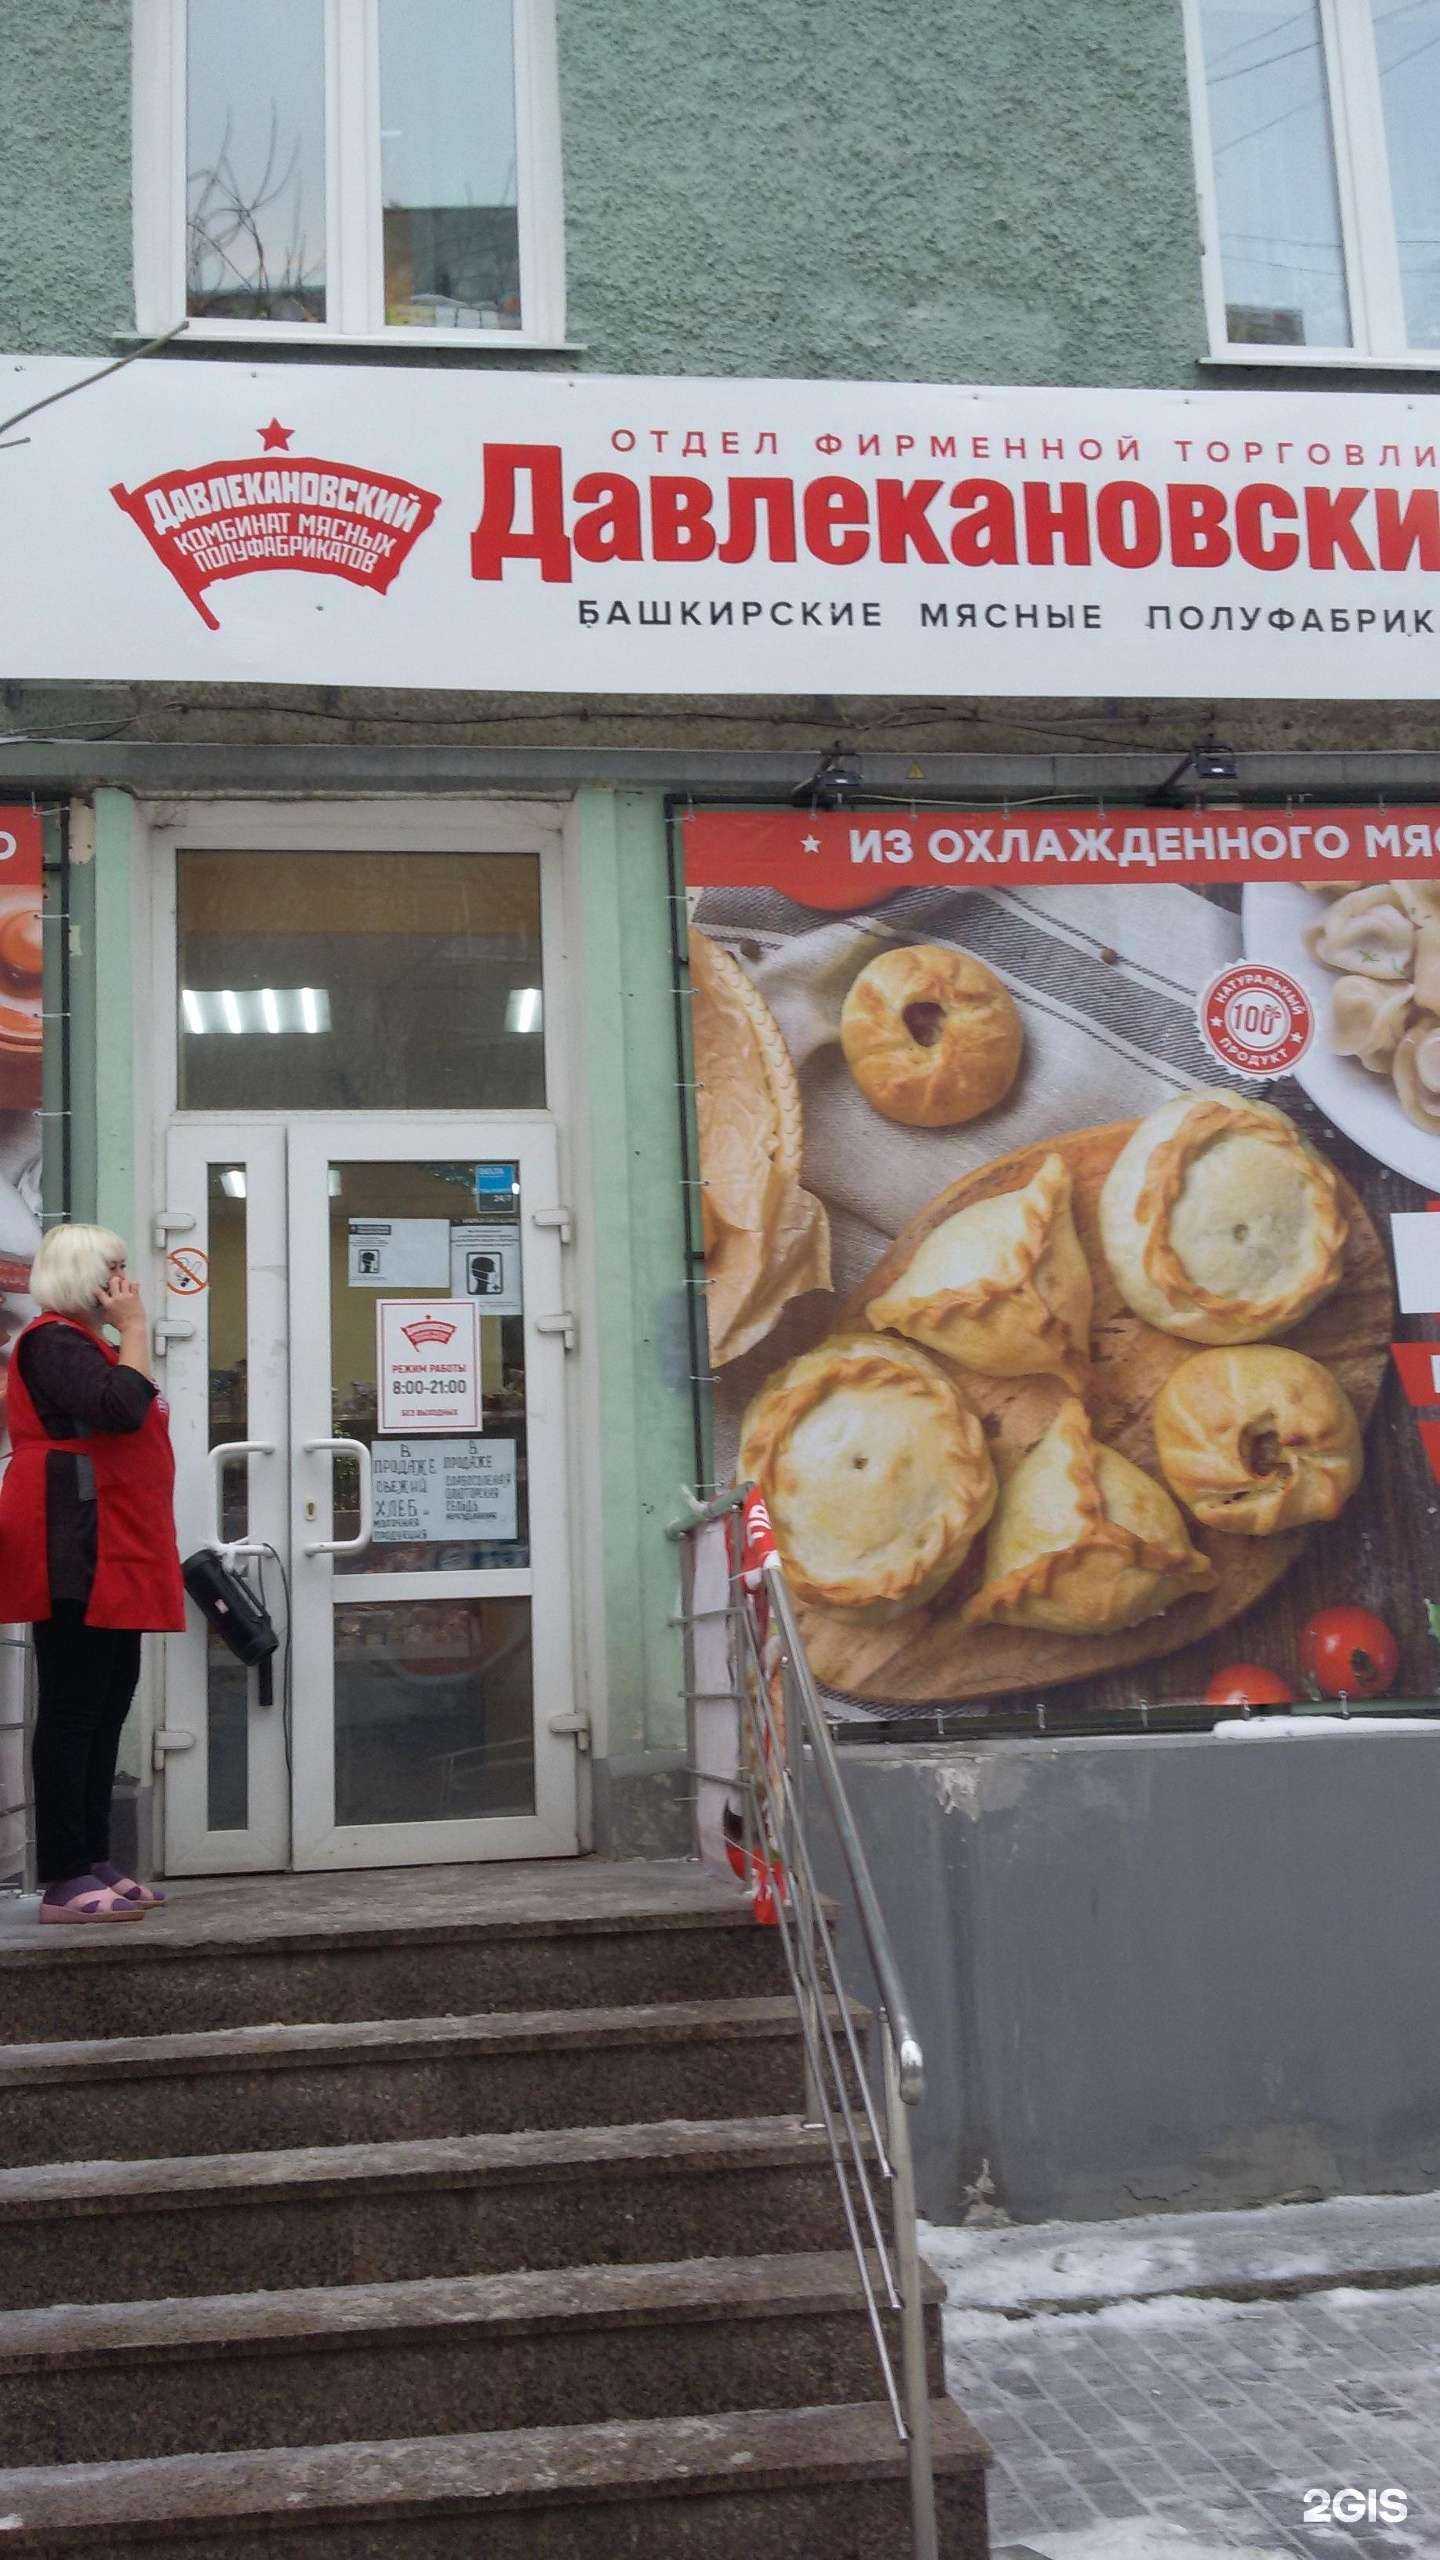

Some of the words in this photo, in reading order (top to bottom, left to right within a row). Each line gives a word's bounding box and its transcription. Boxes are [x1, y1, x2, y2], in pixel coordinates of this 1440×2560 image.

[611, 428, 778, 457] ОТДЕЛ
[815, 433, 1140, 463] ФИРМЕННОЙ
[1174, 440, 1436, 468] ТОРГОВЛИ
[144, 471, 422, 536] ДАВЛЕКАНОВСКИЙ
[470, 442, 1440, 584] Давлекановски
[173, 513, 291, 555] КОМБИНАТ
[298, 513, 398, 557] МЯСНЫХ
[192, 535, 380, 574] ПОЛУФАБРИКАТОВ
[578, 600, 882, 627] БАШКИРСКИЕ
[921, 603, 1101, 629] МЯСНЫЕ
[1147, 606, 1435, 634] ПОЛУФАБРИК
[850, 828, 914, 864] ИЗ
[927, 825, 1350, 868] ОХЛАЖДЕННОГО
[1364, 824, 1440, 859] МЯ
